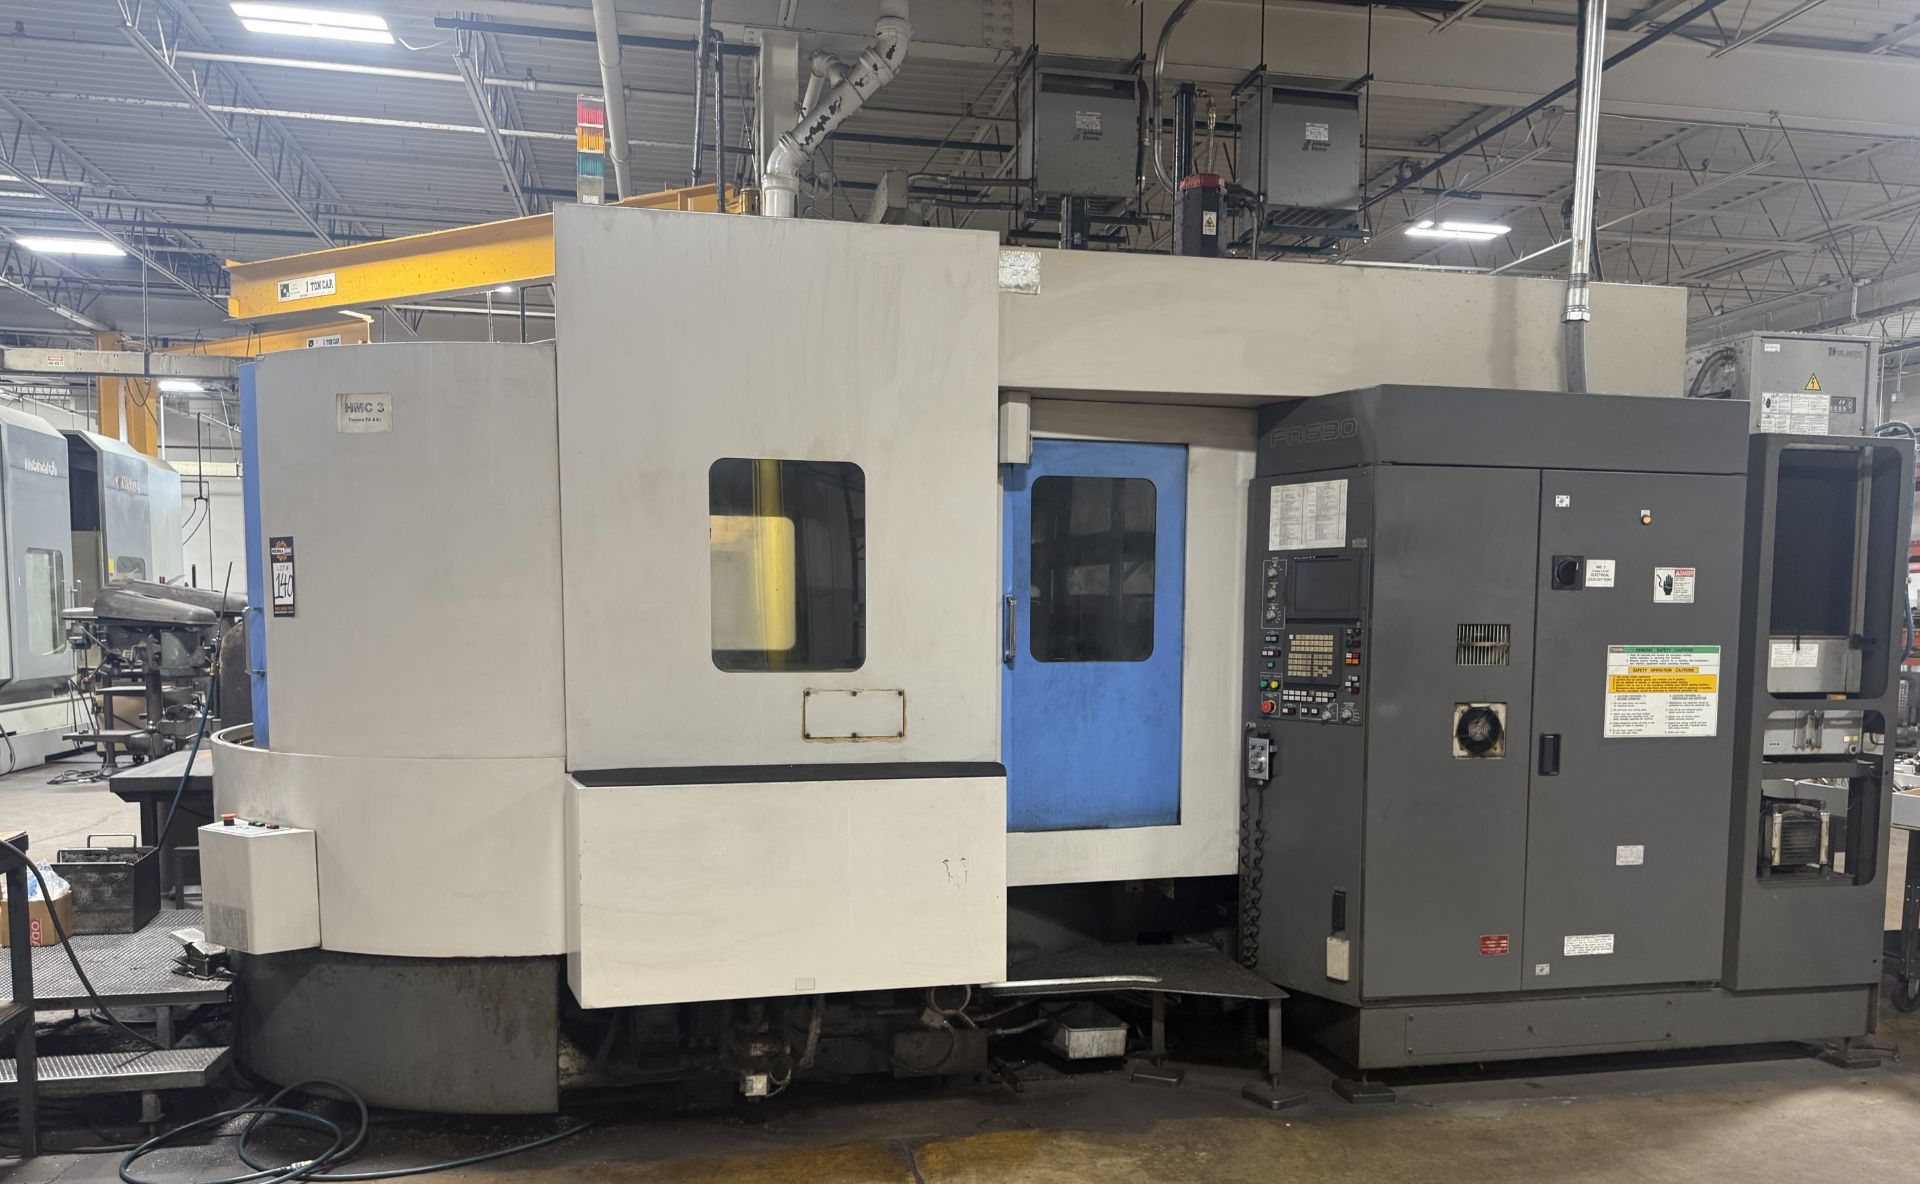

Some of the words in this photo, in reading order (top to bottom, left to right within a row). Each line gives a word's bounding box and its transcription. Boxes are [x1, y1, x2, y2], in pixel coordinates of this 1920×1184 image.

[310, 282, 321, 291] TON
[345, 402, 373, 413] HMC
[377, 402, 385, 413] 3
[1270, 417, 1358, 448] FA630
